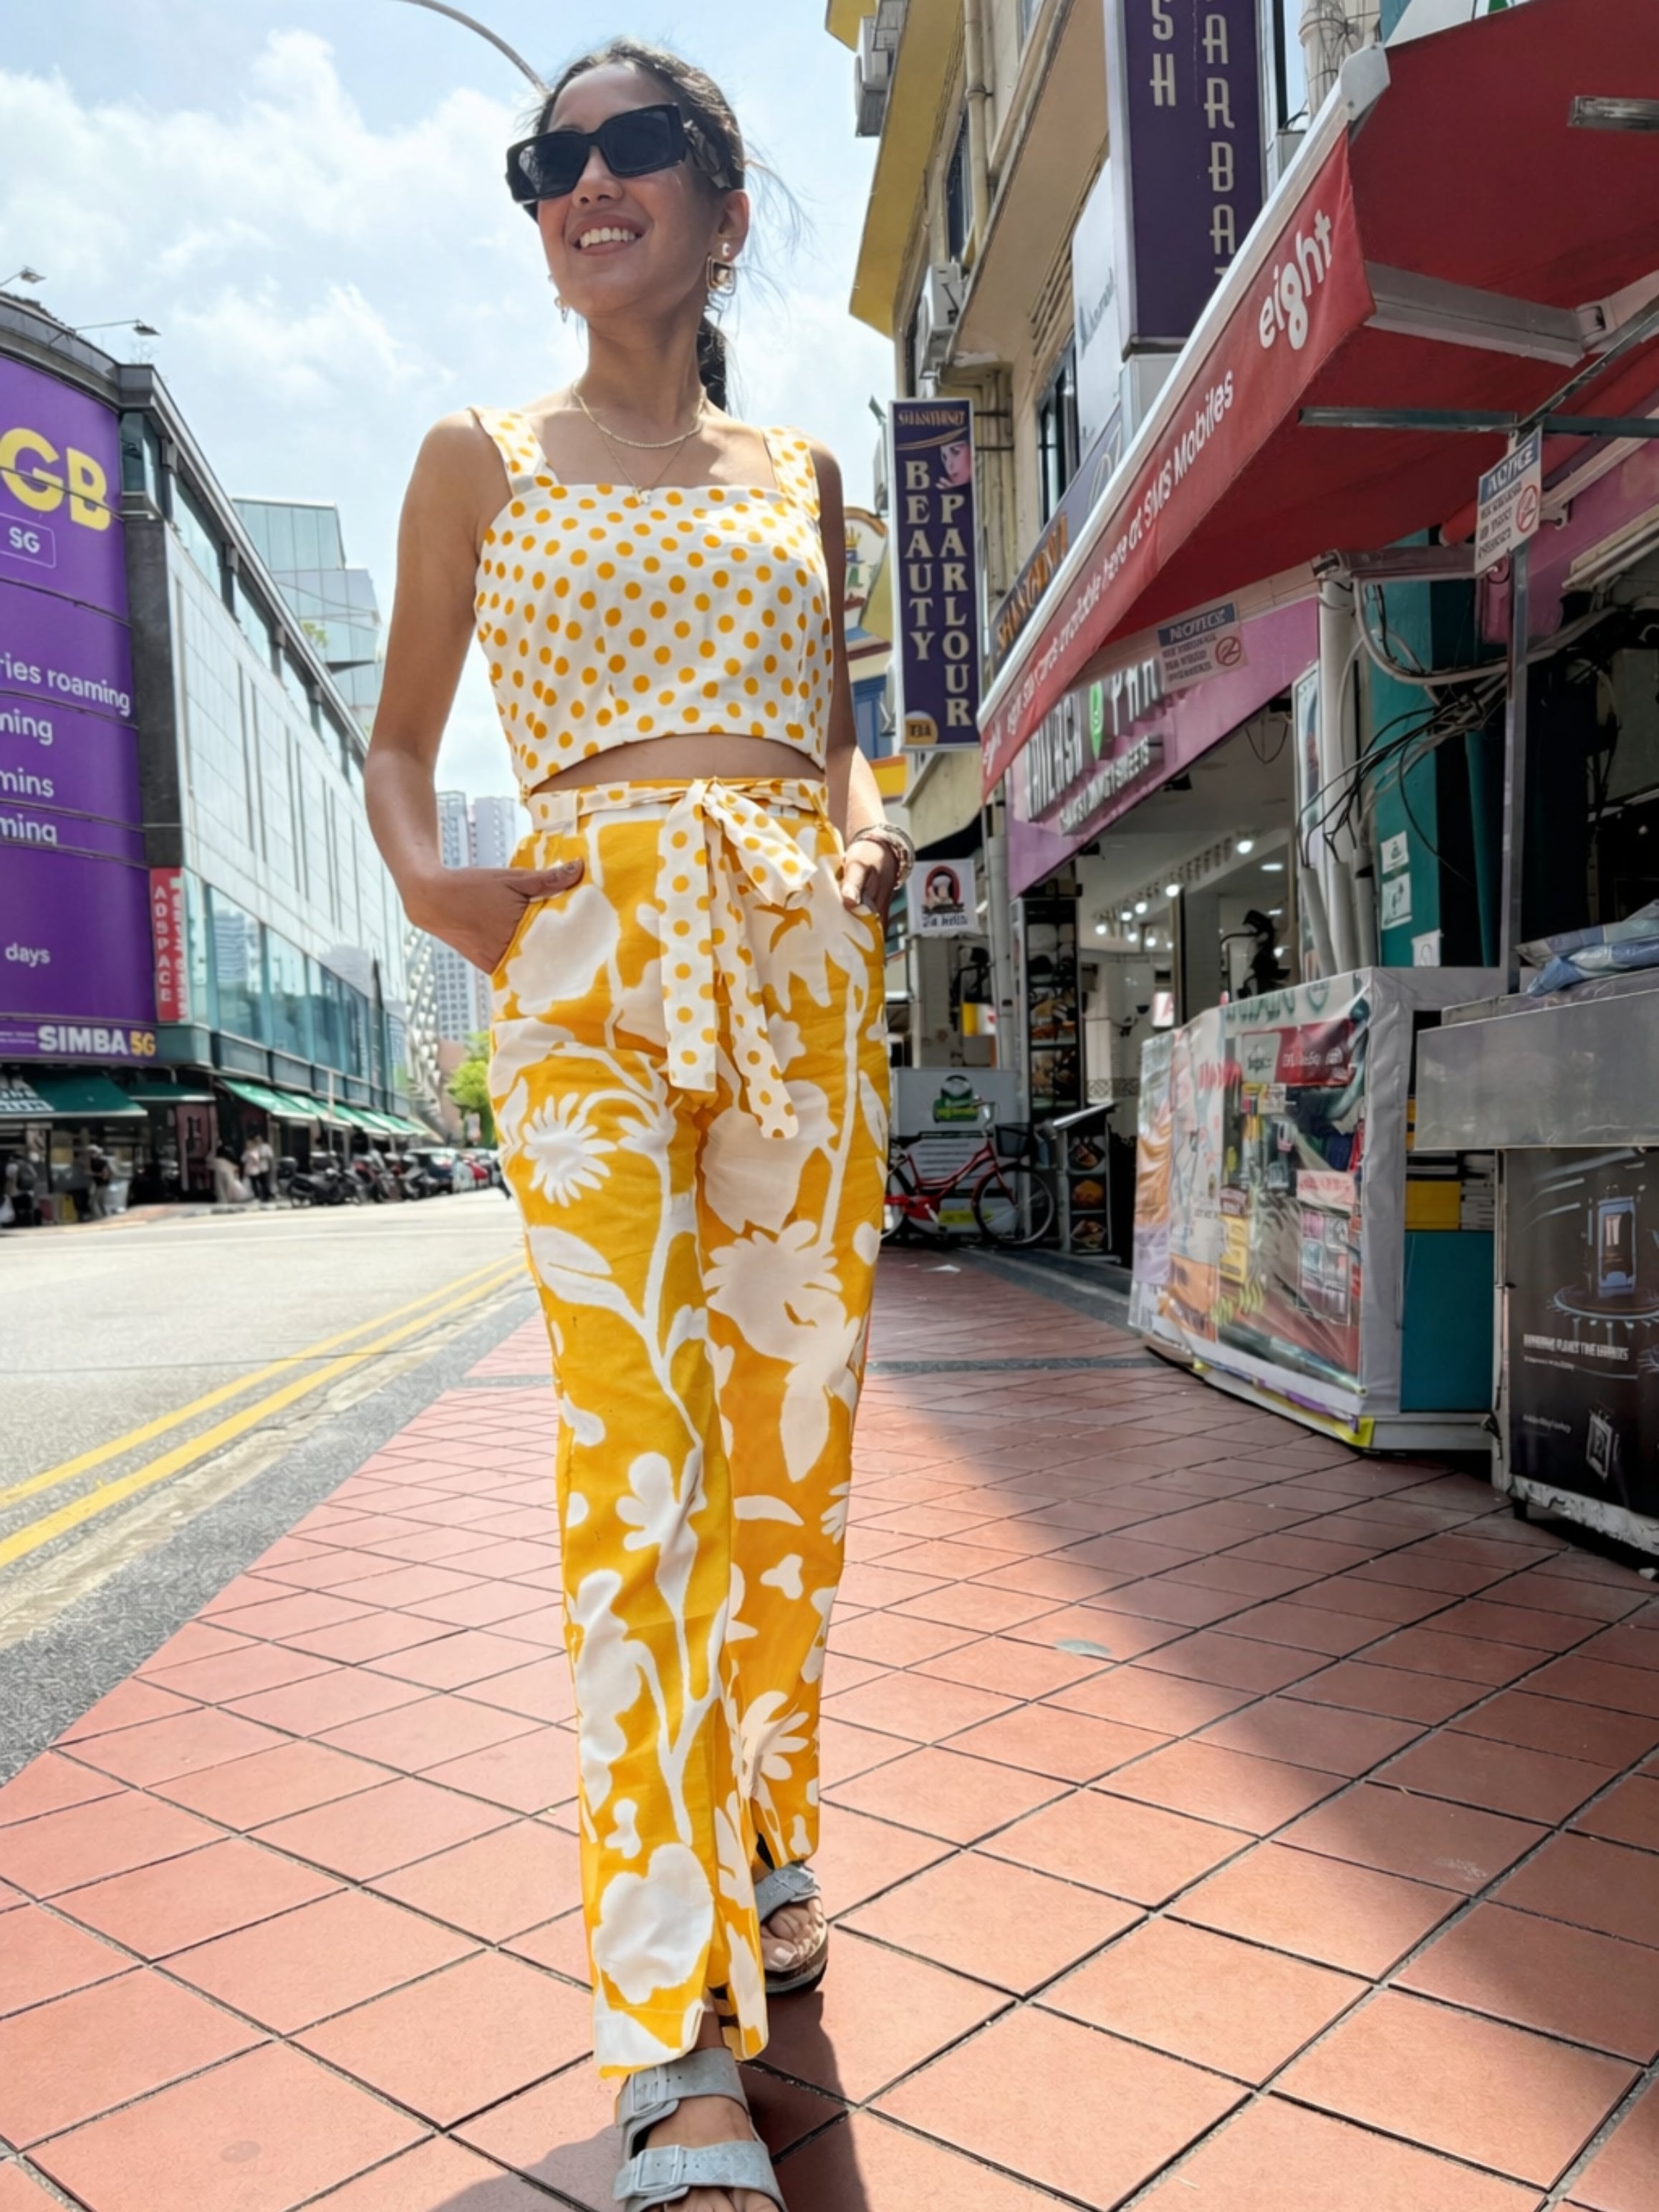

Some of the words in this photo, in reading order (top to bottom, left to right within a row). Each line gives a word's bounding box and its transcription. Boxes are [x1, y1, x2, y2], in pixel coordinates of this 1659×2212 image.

[1259, 210, 1331, 350] eight
[0, 428, 110, 531] GB
[1129, 506, 1143, 551] at
[1144, 458, 1172, 529] SMS
[1174, 370, 1234, 486] Mobiles
[9, 526, 40, 553] SG
[904, 459, 936, 660] BEAUTY
[939, 494, 973, 726] PARLOUR
[47, 669, 130, 717] roaming
[6, 943, 51, 968] days
[154, 885, 172, 1002] ADSPACE
[38, 1024, 129, 1055] SIMBA
[130, 1029, 156, 1057] 5G
